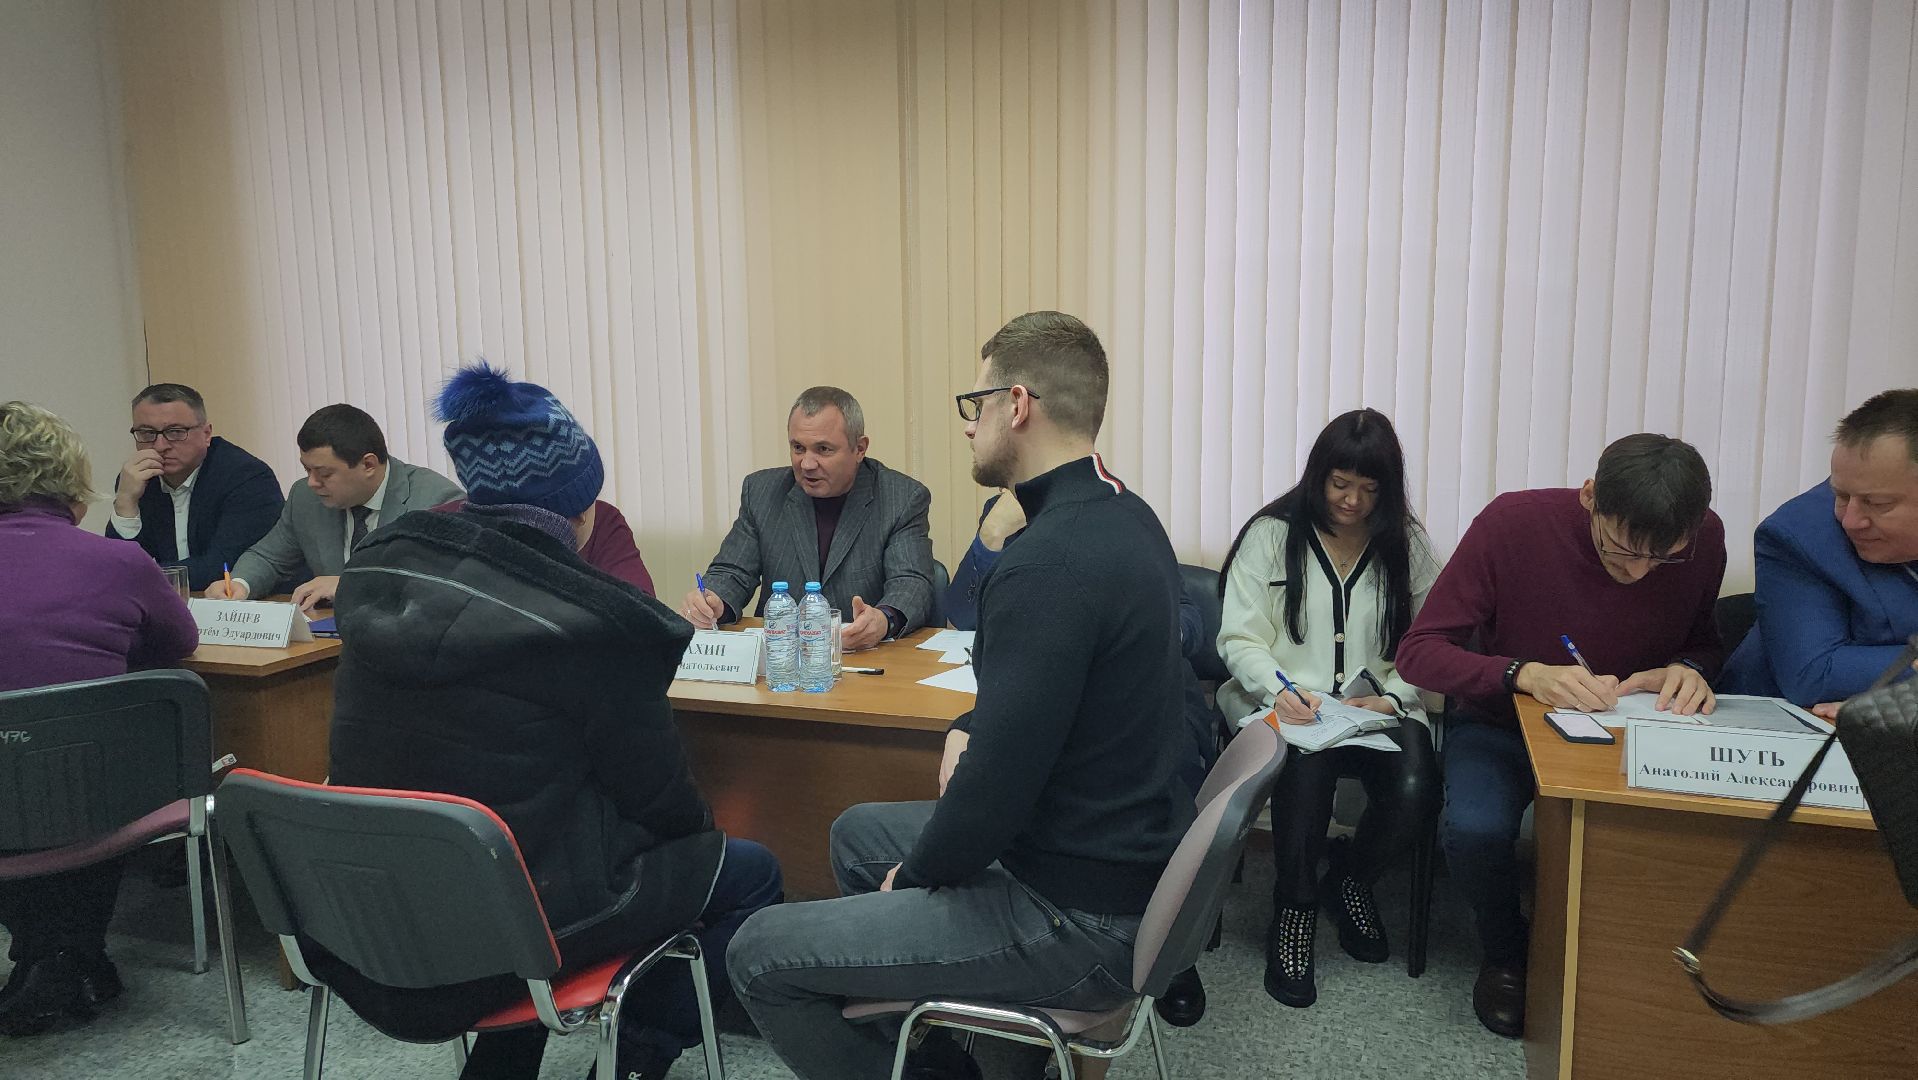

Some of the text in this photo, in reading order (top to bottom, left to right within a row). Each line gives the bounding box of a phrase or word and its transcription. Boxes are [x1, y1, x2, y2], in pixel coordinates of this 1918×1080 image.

[216, 609, 261, 624] ЗАЙЦЕВ
[197, 627, 281, 642] ртём Эдуардович
[680, 662, 740, 673] натольевич
[1709, 746, 1785, 767] ШУТЬ
[1639, 762, 1860, 794] Анатолий Алексарович
